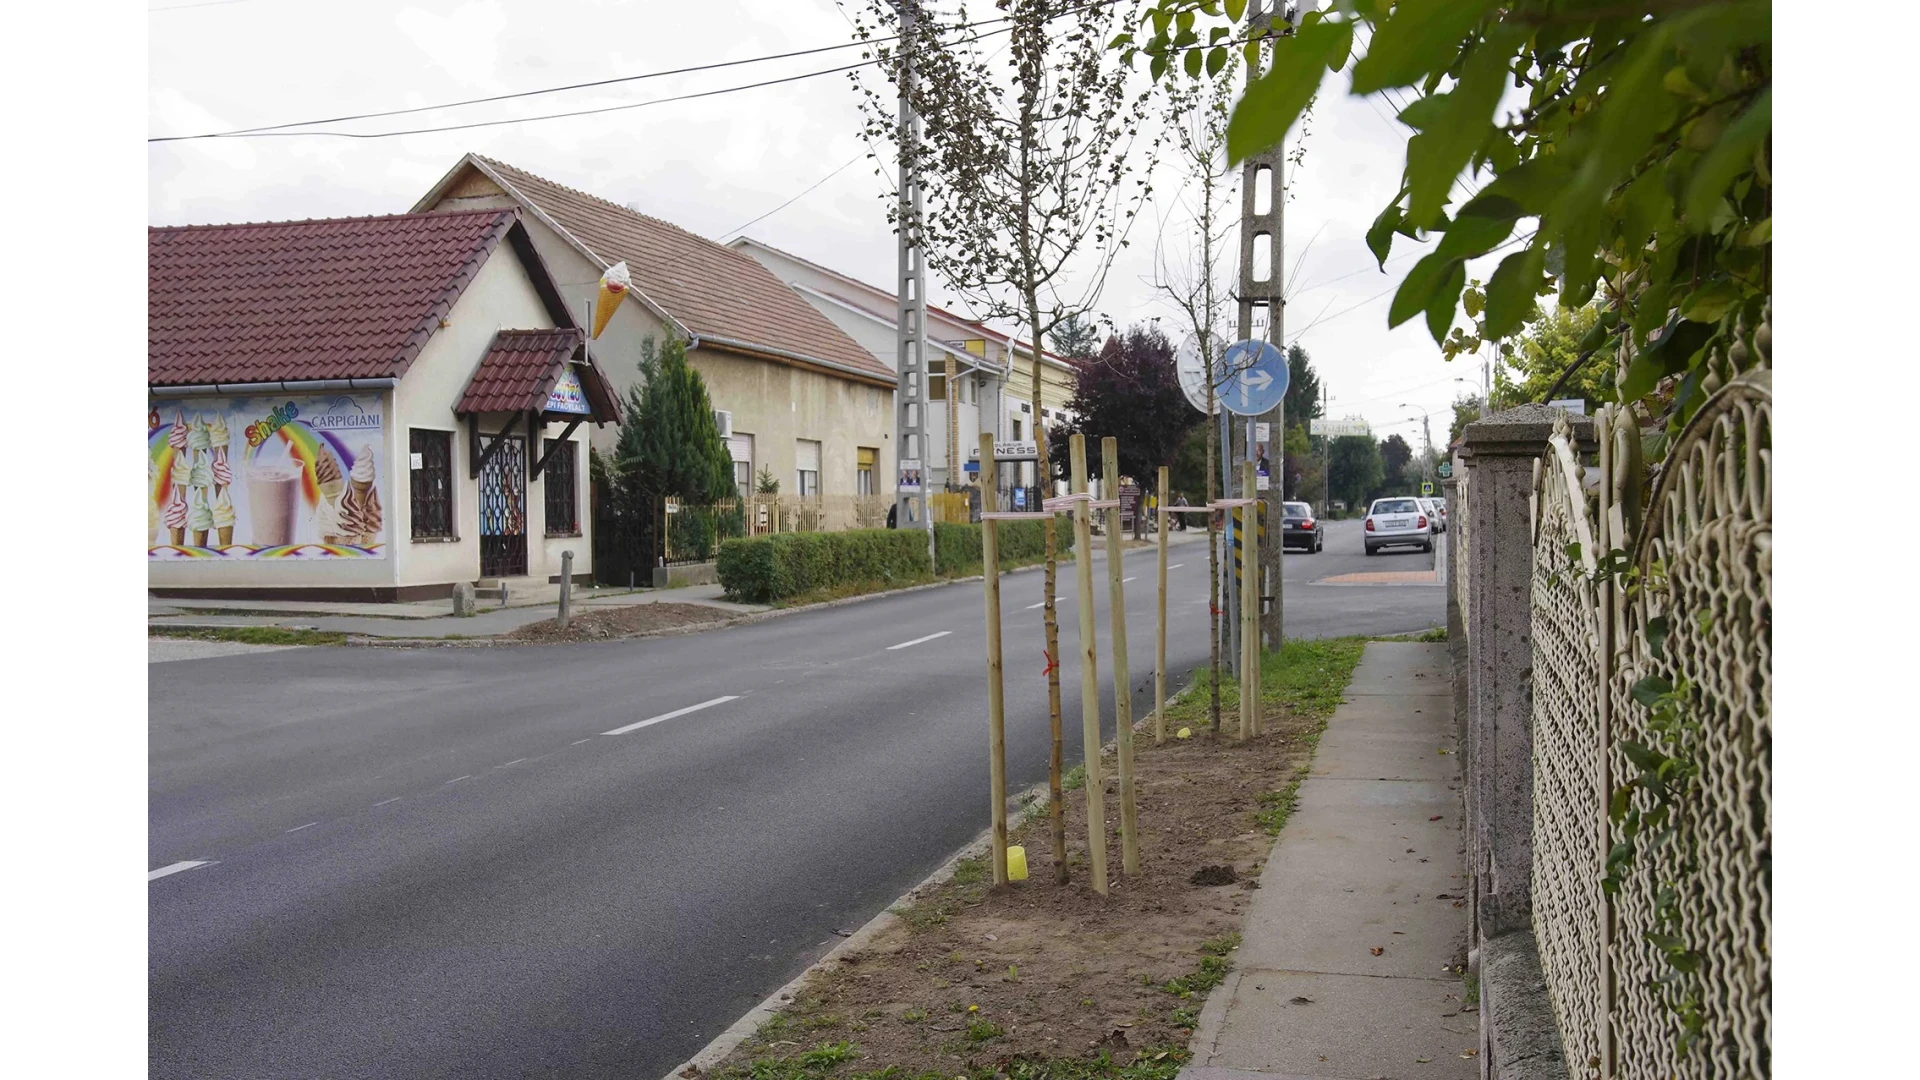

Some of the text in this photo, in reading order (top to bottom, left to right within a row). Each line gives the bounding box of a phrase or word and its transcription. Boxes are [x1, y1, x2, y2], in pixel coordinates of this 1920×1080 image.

[557, 401, 585, 412] FAGYLALT
[244, 400, 300, 448] Shake
[311, 414, 380, 427] CARPIGIANI
[972, 446, 1036, 455] FNESS
